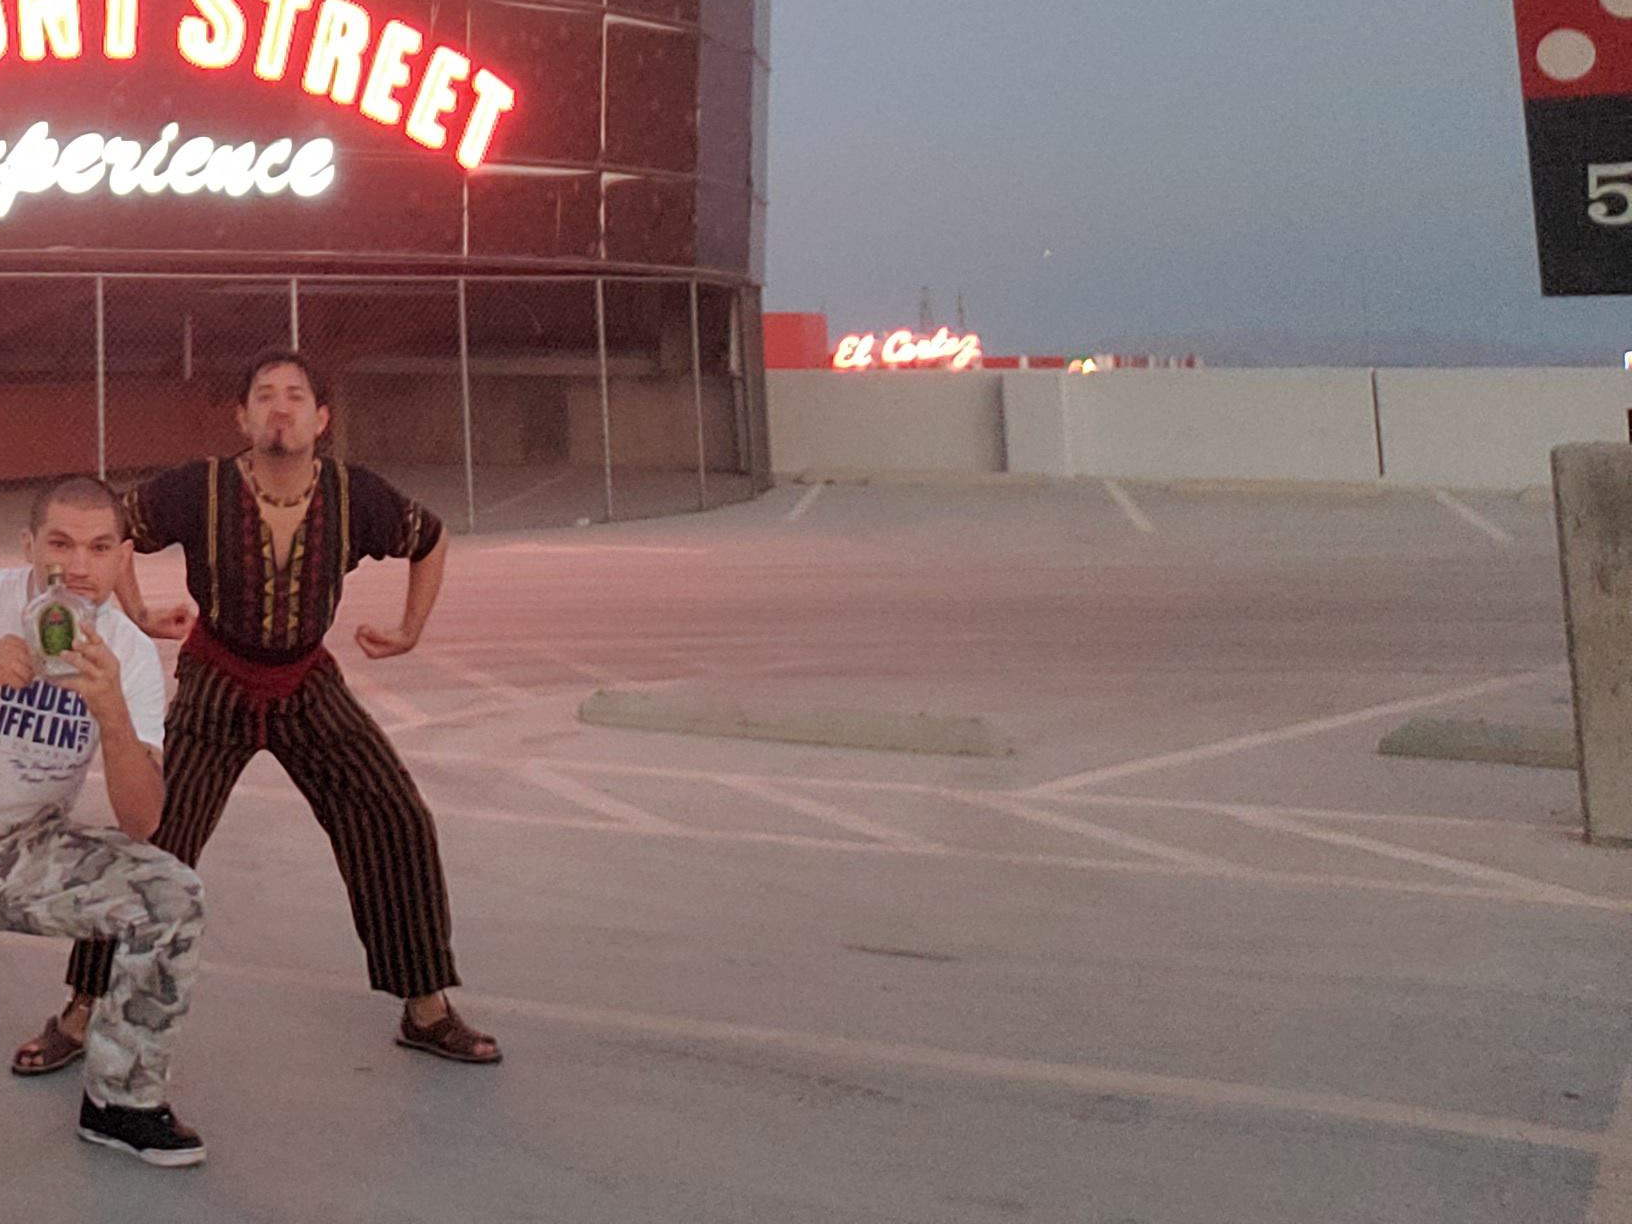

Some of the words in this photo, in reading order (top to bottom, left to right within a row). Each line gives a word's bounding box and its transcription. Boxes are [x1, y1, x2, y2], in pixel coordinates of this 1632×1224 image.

[1587, 161, 1632, 225] 5
[832, 334, 873, 369] El
[881, 327, 981, 370] Cortez
